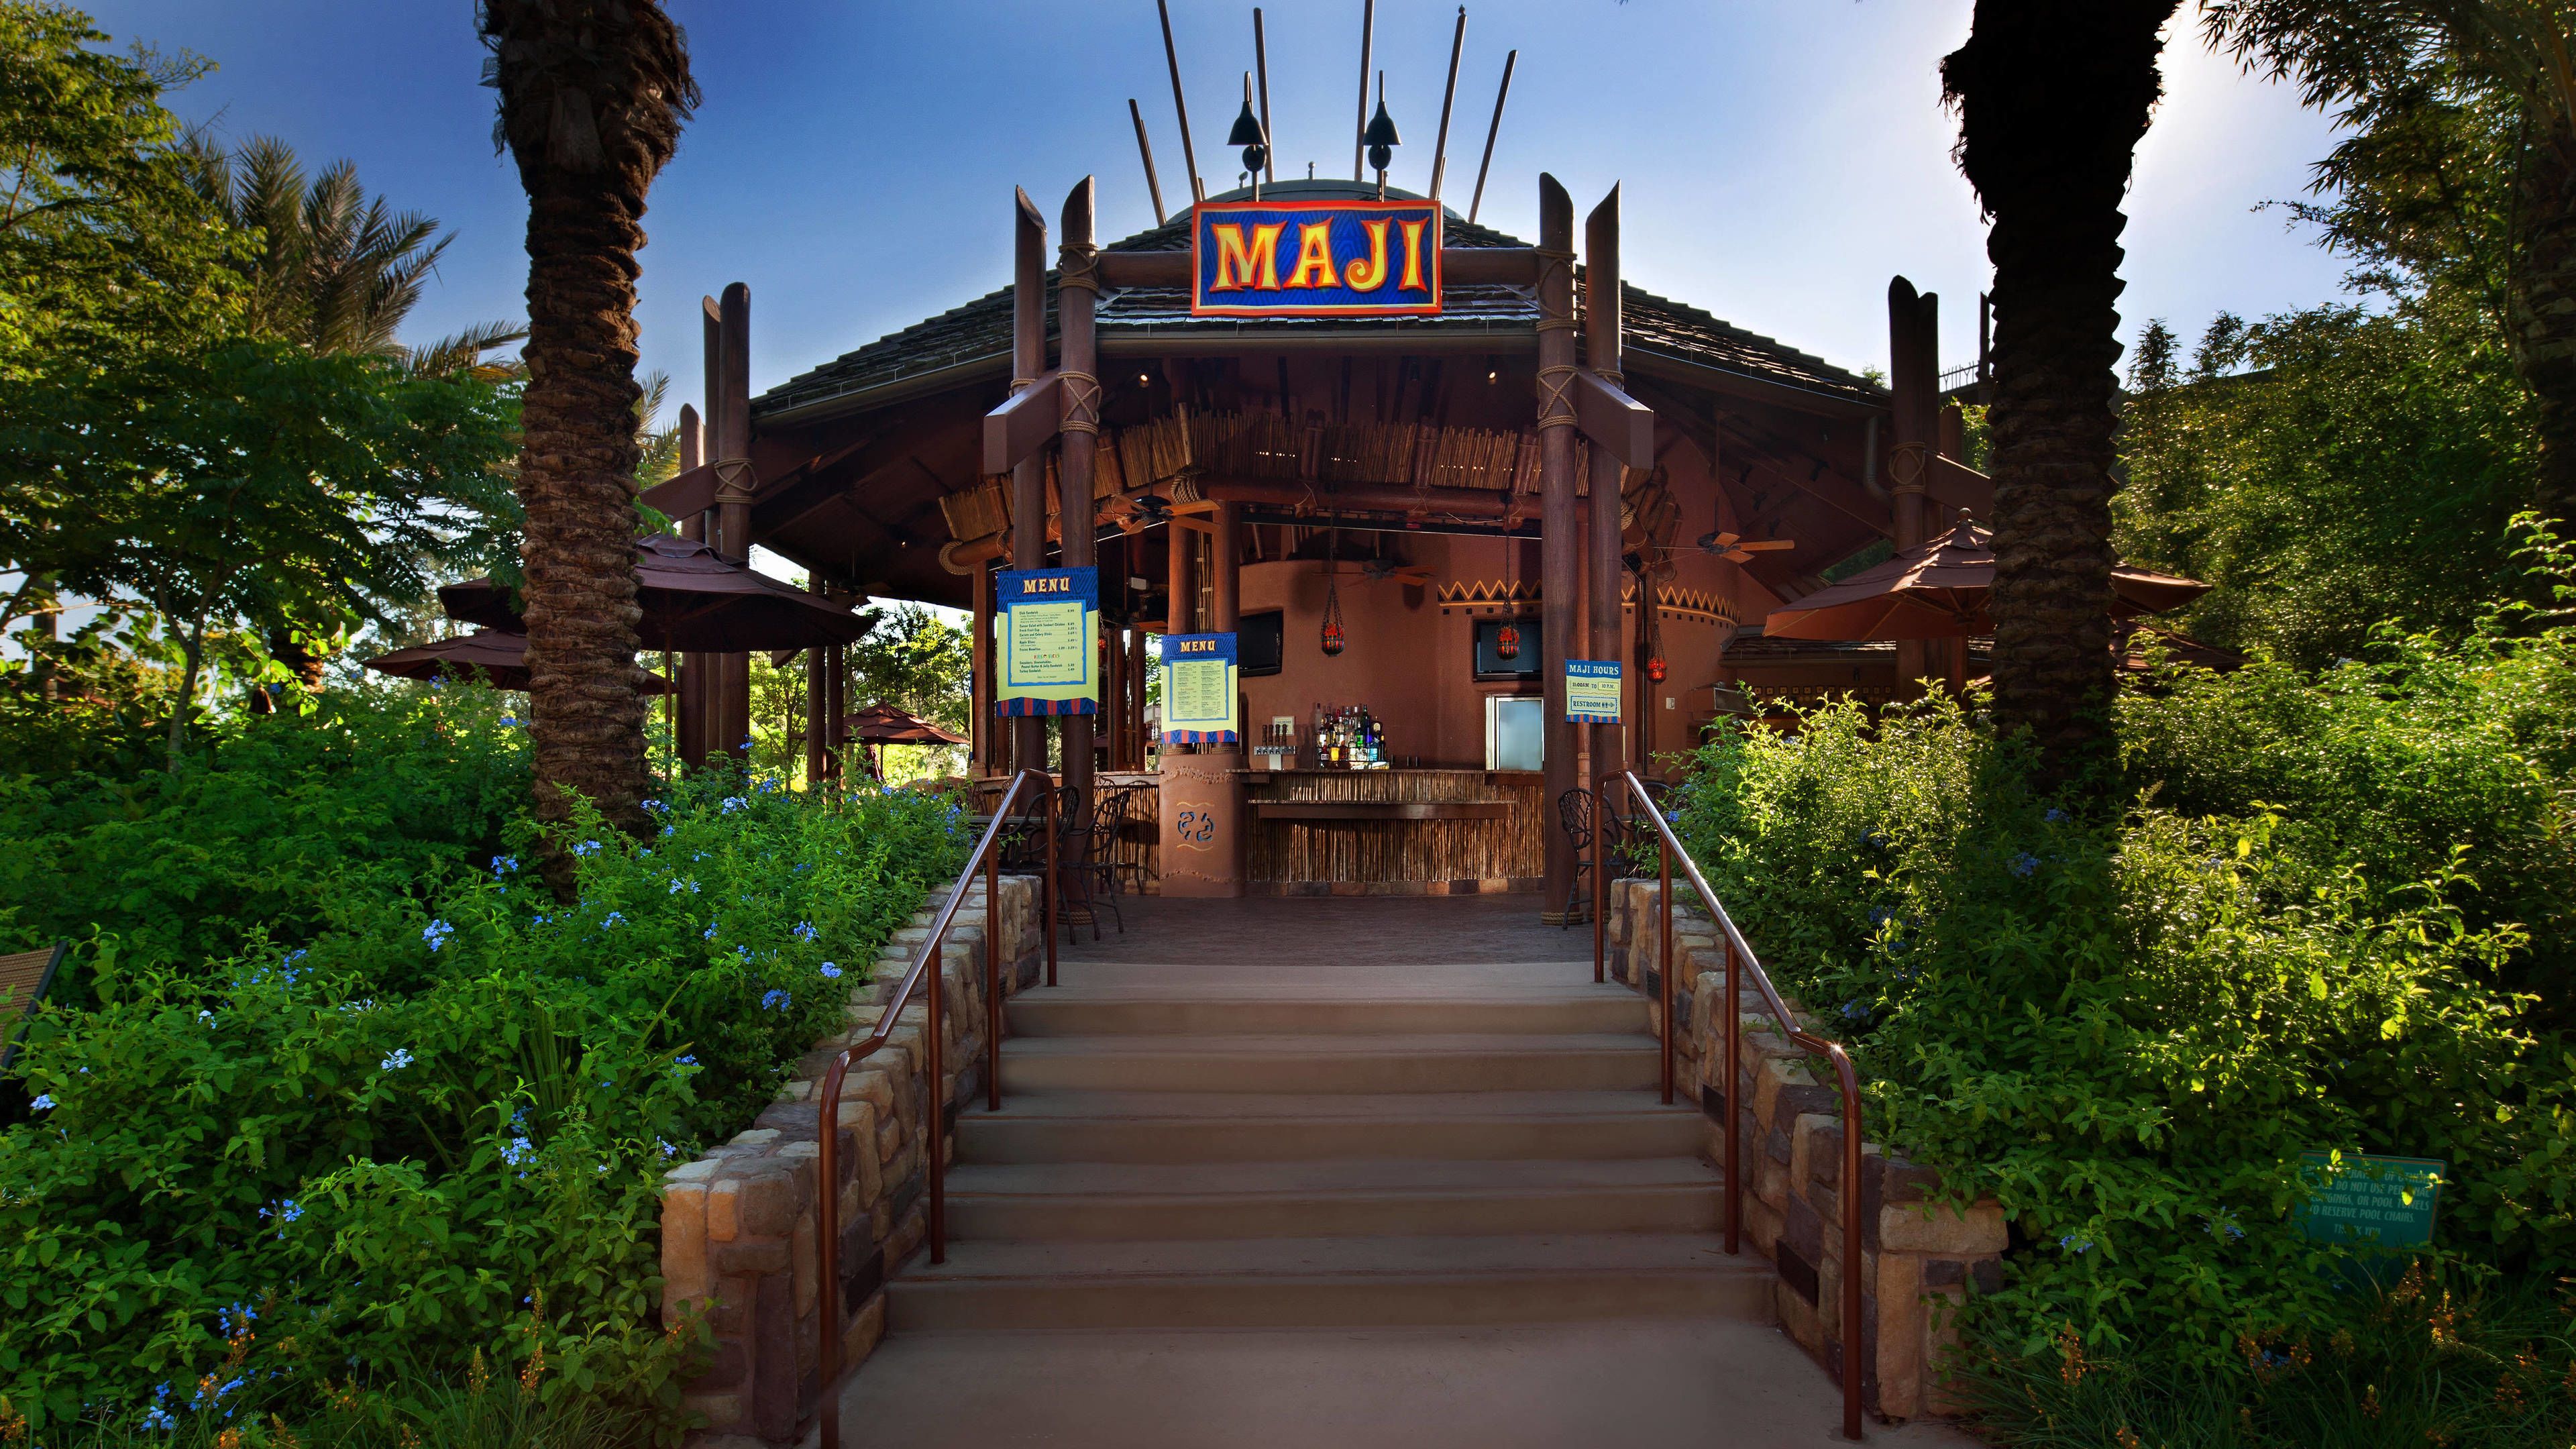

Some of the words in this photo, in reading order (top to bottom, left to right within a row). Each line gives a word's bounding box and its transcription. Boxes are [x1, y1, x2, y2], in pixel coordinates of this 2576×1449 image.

[1209, 216, 1430, 292] MAJI
[1023, 577, 1071, 594] MENU
[1180, 640, 1216, 653] MENU
[1569, 665, 1590, 674] MAJI
[1593, 666, 1619, 676] HOURS
[2336, 1181, 2348, 1191] DO
[2350, 1181, 2368, 1192] NOT
[2370, 1183, 2386, 1194] USE
[2388, 1185, 2431, 1198] PERNAL
[2357, 1195, 2370, 1206] OR
[2372, 1197, 2394, 1208] POOL
[2322, 1205, 2358, 1219] RESERVE
[2359, 1209, 2381, 1220] POOL
[2334, 1223, 2362, 1236] THK
